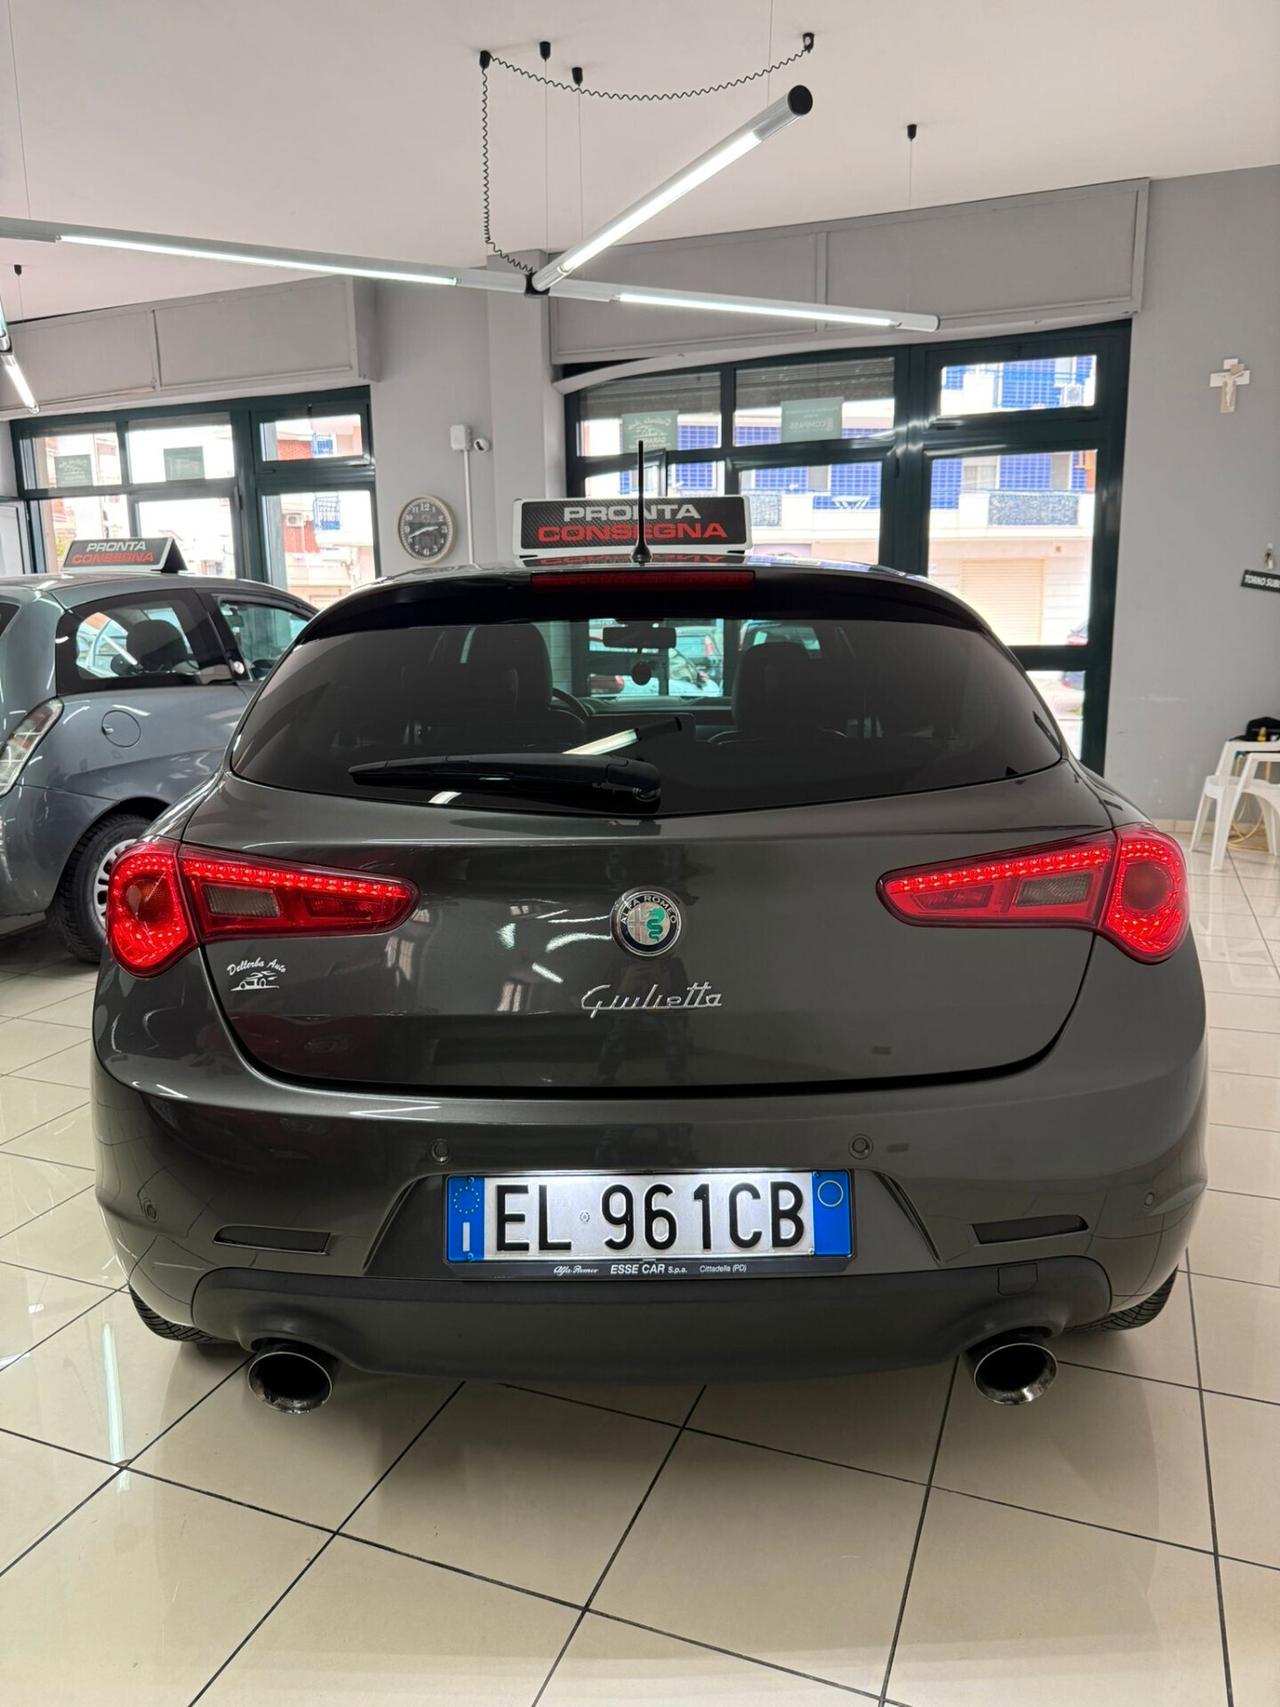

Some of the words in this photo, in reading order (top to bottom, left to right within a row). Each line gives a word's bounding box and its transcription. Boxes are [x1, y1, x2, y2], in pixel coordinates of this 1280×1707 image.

[563, 504, 701, 522] PRONTA
[538, 523, 728, 542] CONSEGNA
[86, 541, 147, 552] PRONTA
[620, 898, 641, 924] ALFA
[644, 895, 678, 924] ROMEO
[580, 981, 722, 1019] Giulietta
[496, 1184, 572, 1251] EL
[601, 1181, 805, 1251] 961CB
[610, 1264, 639, 1275] ESSE
[641, 1264, 665, 1274] CAR
[667, 1265, 688, 1274] S.p.a.
[699, 1265, 731, 1273] Cittadella
